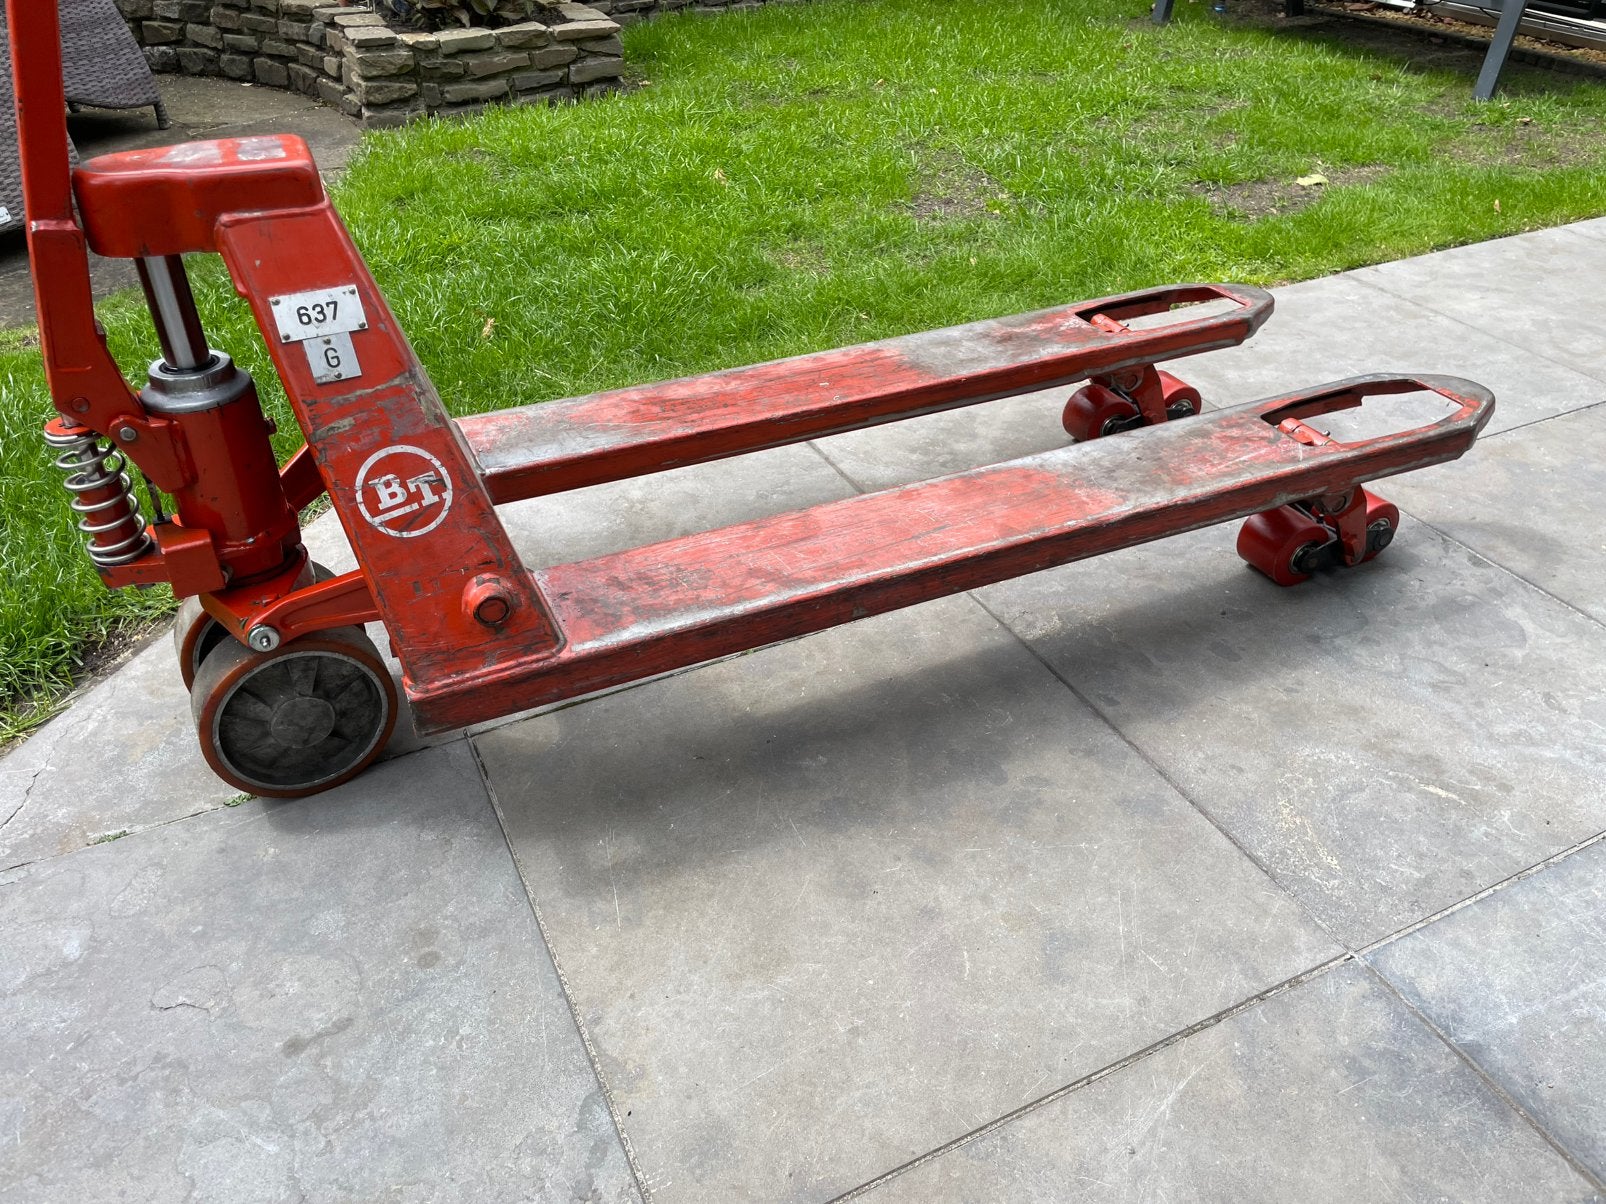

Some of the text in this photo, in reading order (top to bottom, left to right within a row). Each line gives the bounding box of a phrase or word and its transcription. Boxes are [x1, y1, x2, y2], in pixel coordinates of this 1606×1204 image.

[296, 300, 338, 325] 637
[324, 347, 341, 368] G
[368, 471, 440, 510] BT
